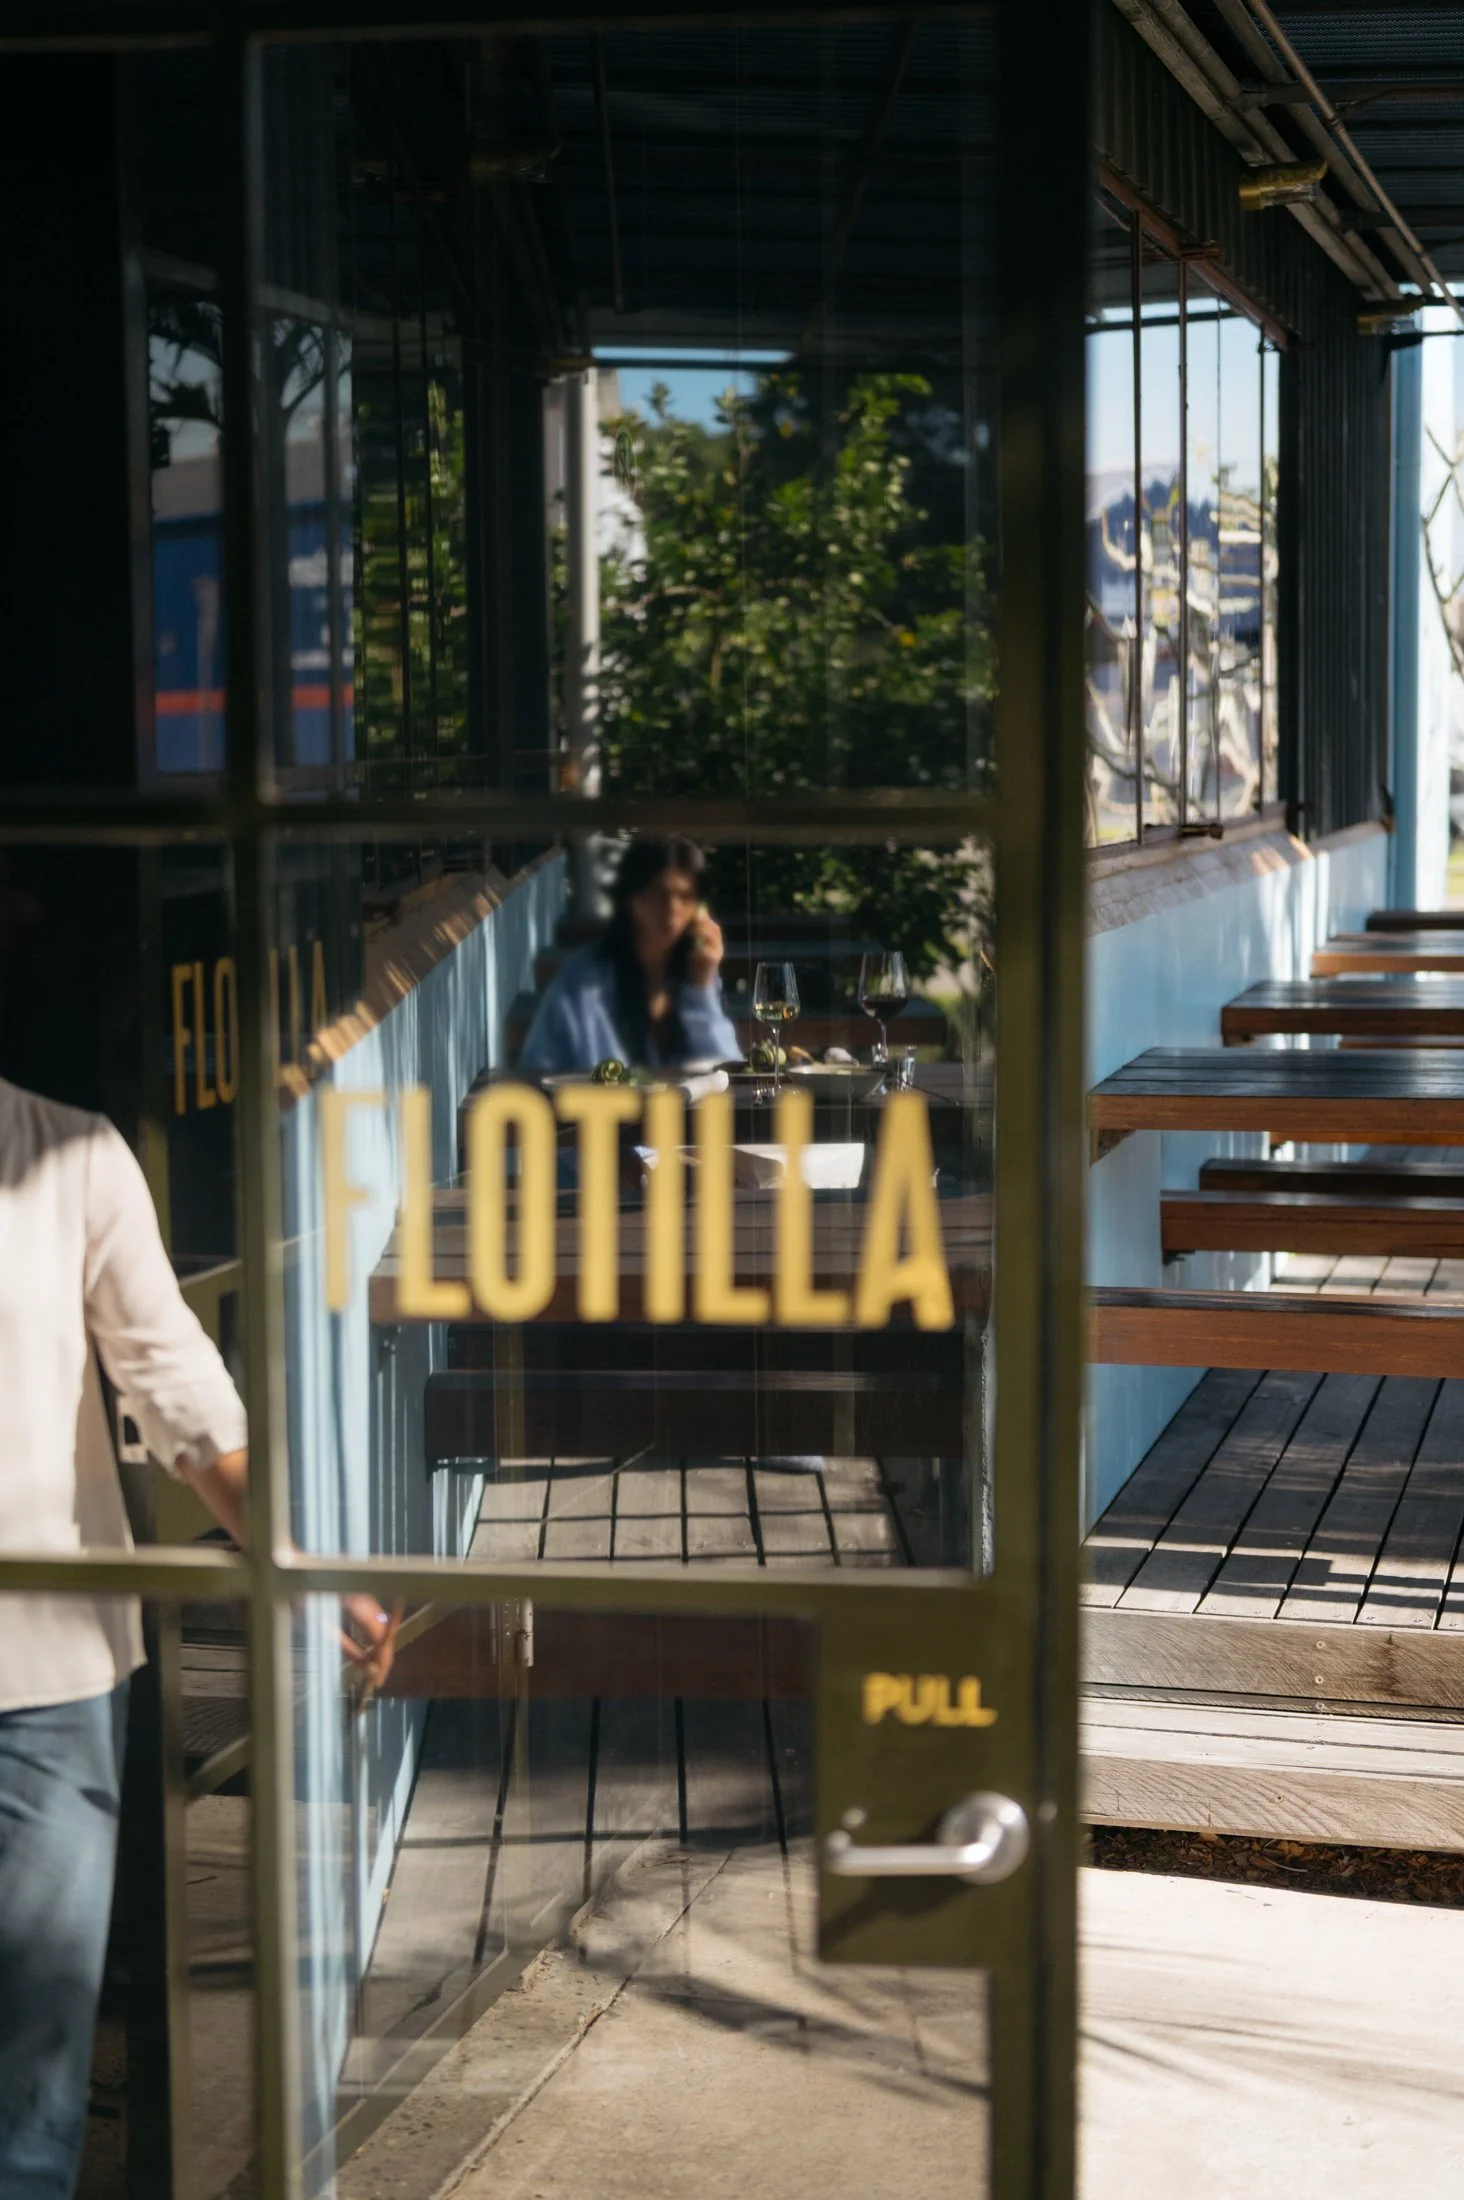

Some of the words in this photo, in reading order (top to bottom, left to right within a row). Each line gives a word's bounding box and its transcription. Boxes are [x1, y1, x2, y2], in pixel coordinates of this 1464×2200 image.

[171, 940, 328, 1115] FLOLLA
[320, 1084, 954, 1331] FLOTILLA
[863, 1672, 998, 1728] PULL
